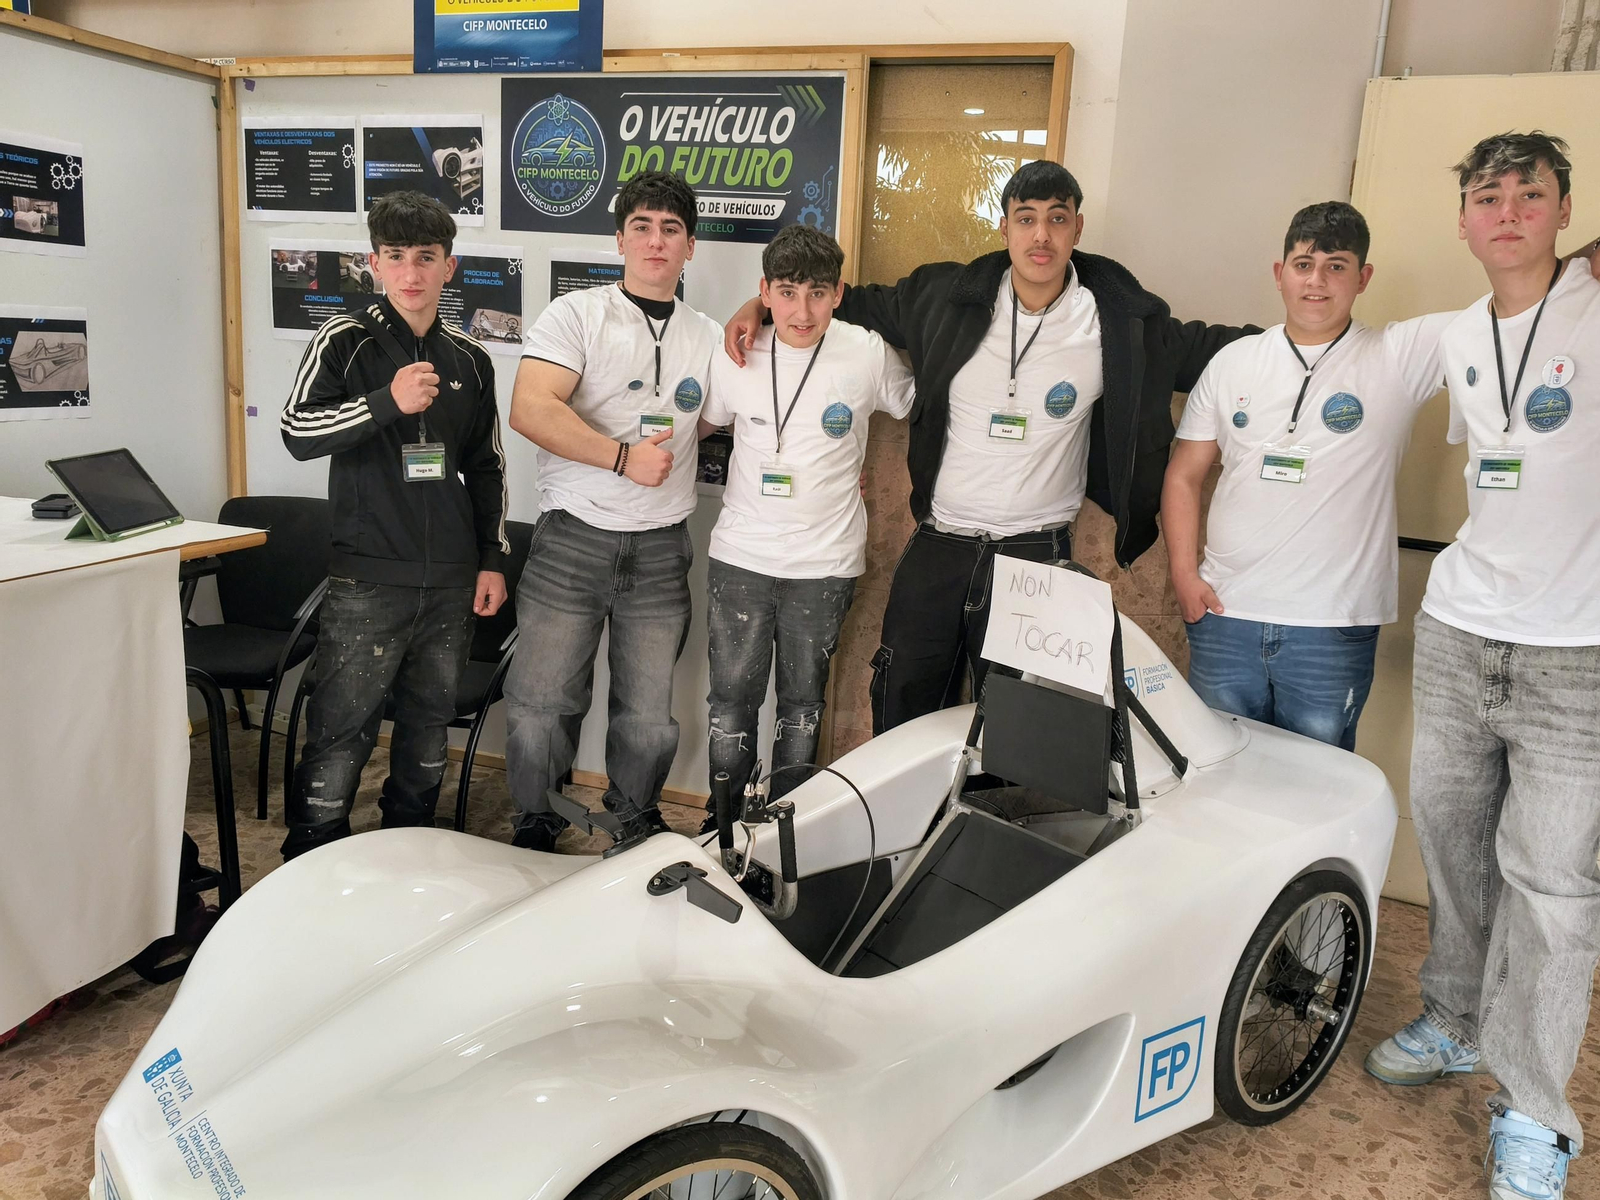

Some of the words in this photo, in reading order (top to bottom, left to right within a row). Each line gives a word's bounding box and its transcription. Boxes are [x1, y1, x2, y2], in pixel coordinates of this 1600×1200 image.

[463, 20, 484, 32] CIFP
[486, 18, 548, 31] MONTECELO
[619, 105, 644, 142] O
[649, 97, 796, 145] VEHÍCULO
[5, 153, 39, 165] TEÓRICOS
[670, 145, 794, 188] FUTURO
[517, 167, 539, 179] CIFP
[540, 167, 600, 181] MONTECELO
[521, 182, 528, 190] O
[526, 189, 559, 213] VEHÍCULO
[559, 204, 571, 213] DO
[571, 184, 595, 210] FUTURO
[708, 202, 721, 214] DE
[723, 200, 776, 216] VEHÍCULOS
[463, 269, 492, 278] PROCESO
[491, 270, 500, 278] DE
[463, 277, 504, 287] ELABORACIÓN
[588, 267, 621, 276] MATERIAIS
[304, 294, 344, 303] CONCLUSIÓN
[1008, 567, 1053, 598] NON
[1010, 612, 1095, 674] TOCAR
[1142, 663, 1168, 676] FORMACIÓN
[1144, 671, 1173, 685] PROFESIONAL
[1148, 1041, 1191, 1100] FP
[151, 1076, 169, 1094] DE
[168, 1065, 194, 1103] XUNTA
[157, 1091, 183, 1131] GALICIA
[174, 1132, 204, 1180] MONTECELO
[185, 1125, 215, 1171] FORMACIÓN
[197, 1117, 221, 1151] CENTRO
[214, 1148, 241, 1188] INTEGRADO
[233, 1184, 247, 1199] DE
